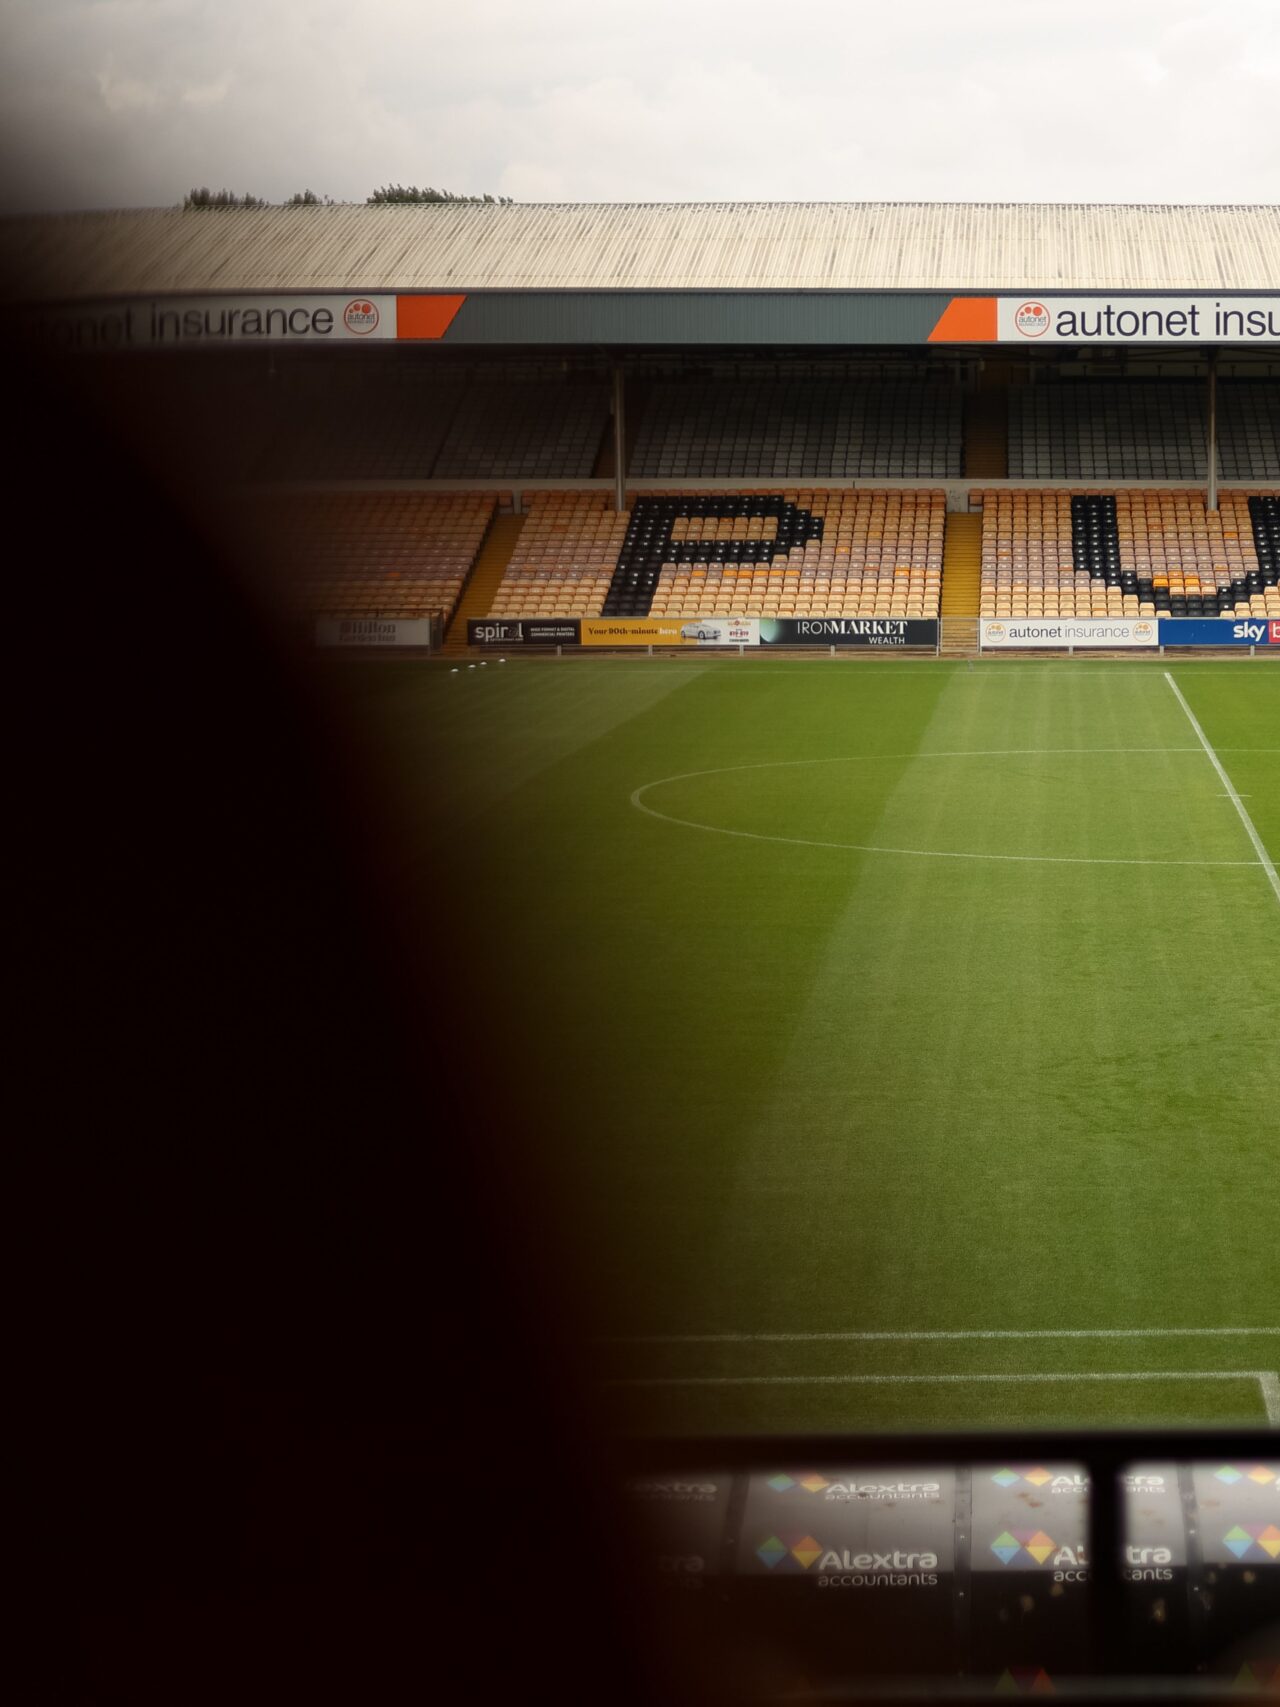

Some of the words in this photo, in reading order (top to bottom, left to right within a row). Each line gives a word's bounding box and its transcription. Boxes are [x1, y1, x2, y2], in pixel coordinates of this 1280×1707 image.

[151, 303, 334, 338] insurance
[1019, 315, 1046, 323] autonet
[1056, 304, 1200, 337] autonet
[598, 494, 825, 617] P
[588, 627, 607, 636] Your
[1009, 625, 1062, 639] autonet
[1064, 625, 1130, 639] insurance
[1233, 621, 1266, 641] sky
[868, 636, 905, 645] WEALTH
[825, 1482, 941, 1494] Alextra
[824, 1492, 941, 1501] accountants
[819, 1549, 938, 1570] Alextra
[1053, 1545, 1172, 1566] Altra
[818, 1573, 938, 1588] accountants
